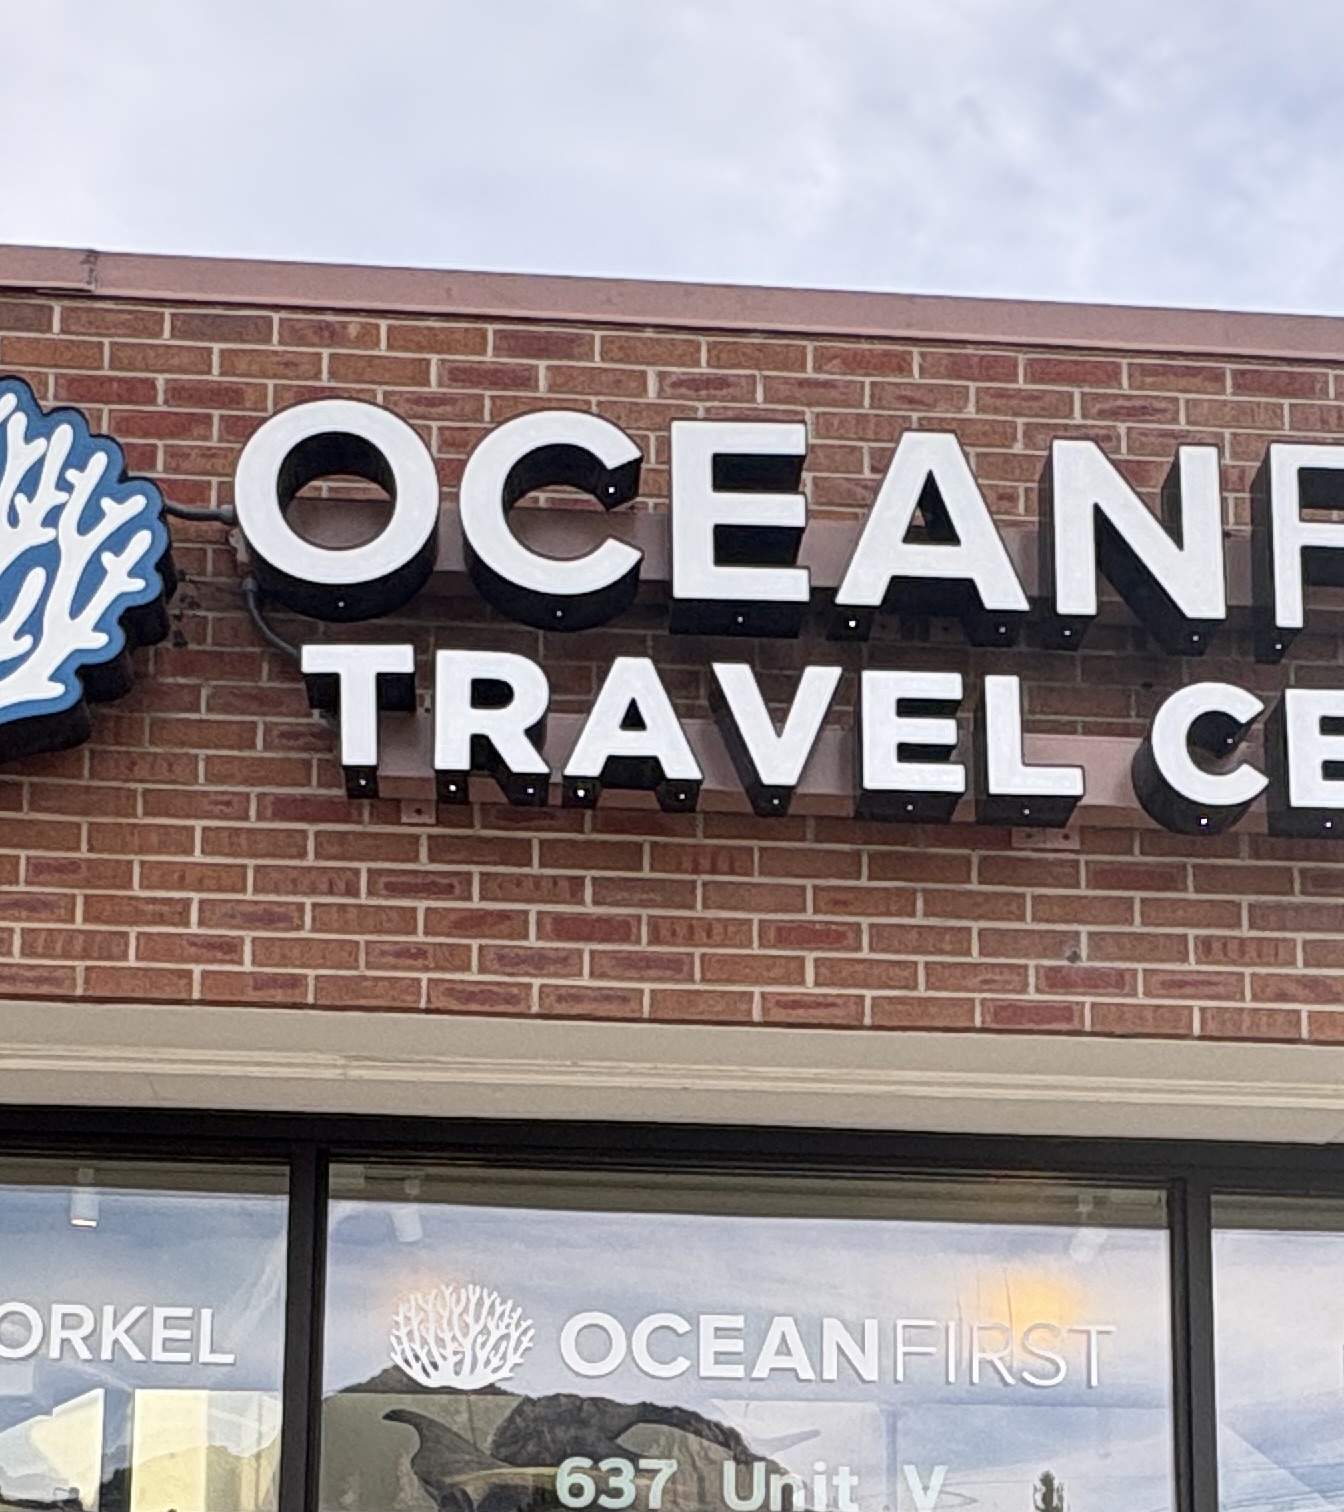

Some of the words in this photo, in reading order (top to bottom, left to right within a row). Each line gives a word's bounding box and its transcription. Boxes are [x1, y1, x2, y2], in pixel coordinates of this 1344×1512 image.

[300, 643, 1086, 808] TRAVEL
[558, 1311, 1118, 1388] OCEANFIRST
[554, 1456, 678, 1512] 637
